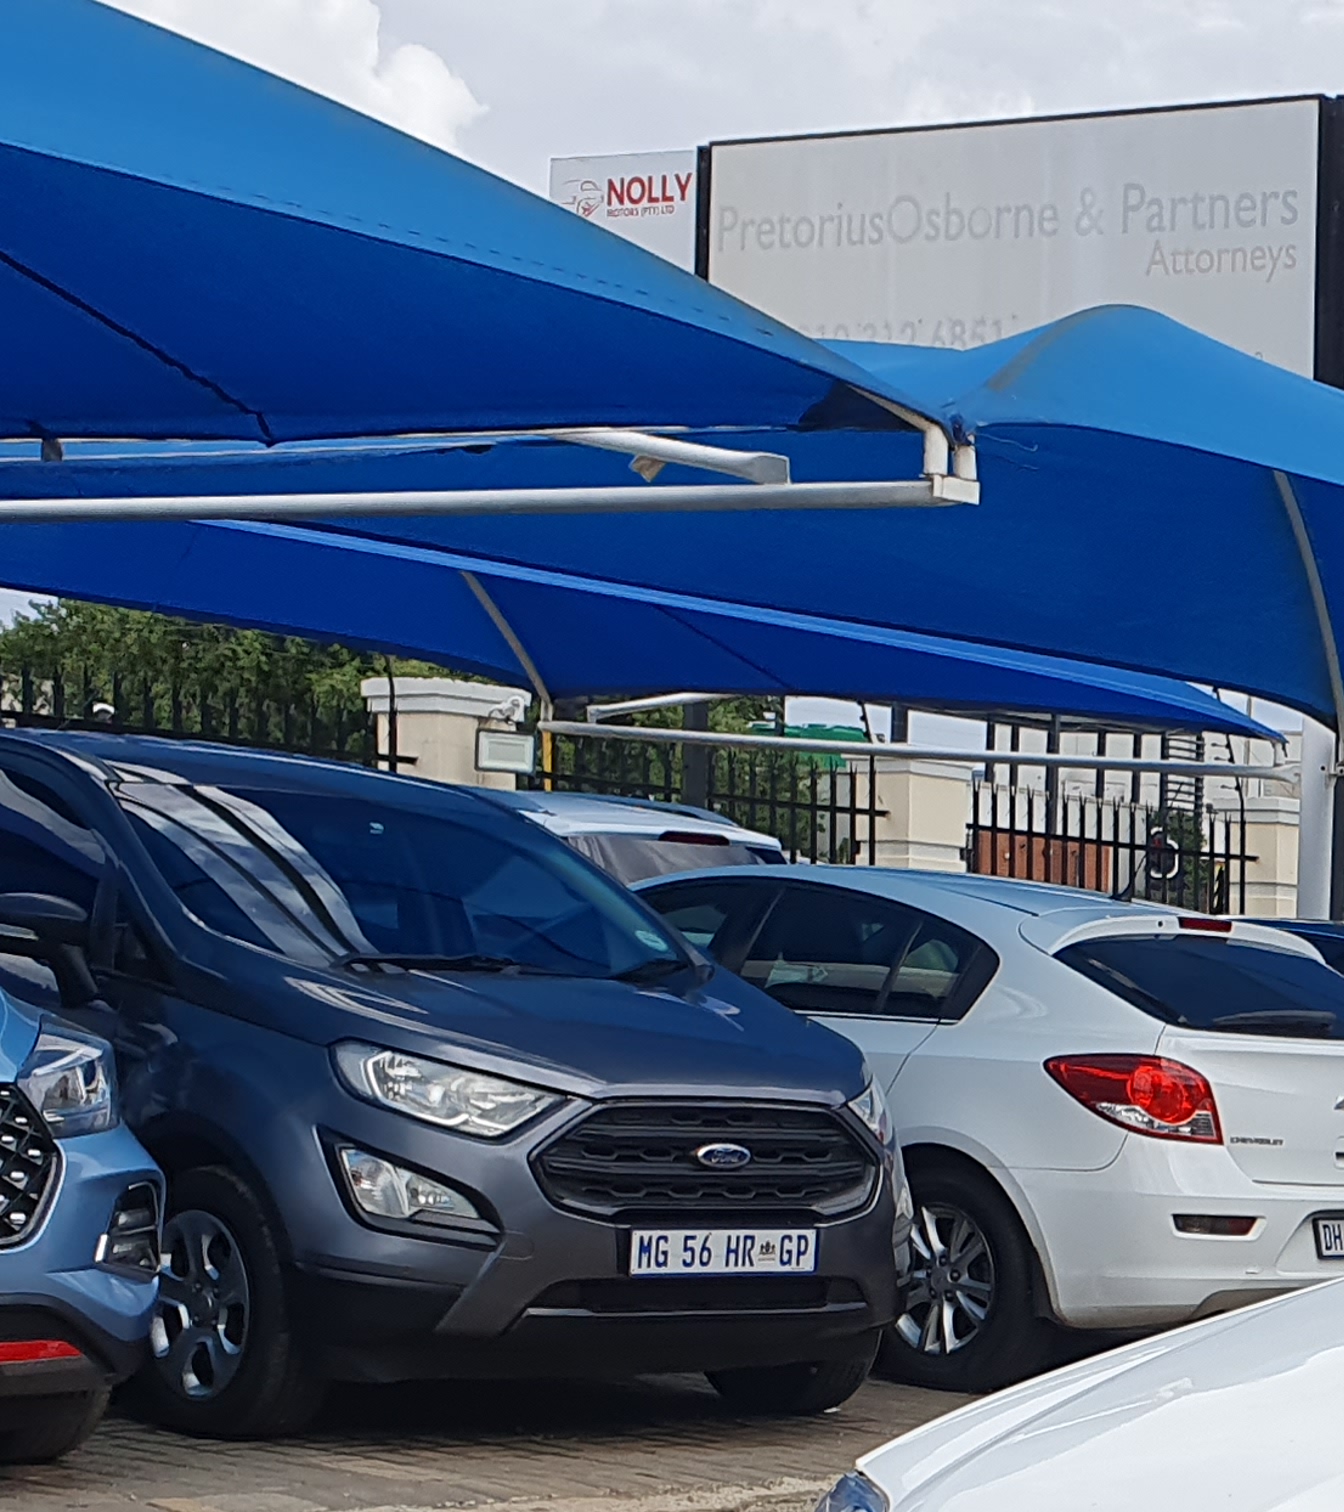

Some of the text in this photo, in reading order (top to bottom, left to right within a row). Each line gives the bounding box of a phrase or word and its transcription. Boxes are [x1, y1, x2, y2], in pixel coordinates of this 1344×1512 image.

[607, 172, 693, 207] NOLLY
[1074, 187, 1105, 237] &
[1121, 183, 1299, 235] Partners
[1145, 239, 1297, 284] Attorneys
[637, 1234, 810, 1269] MG 56 HR GP
[1322, 1223, 1344, 1252] DH
